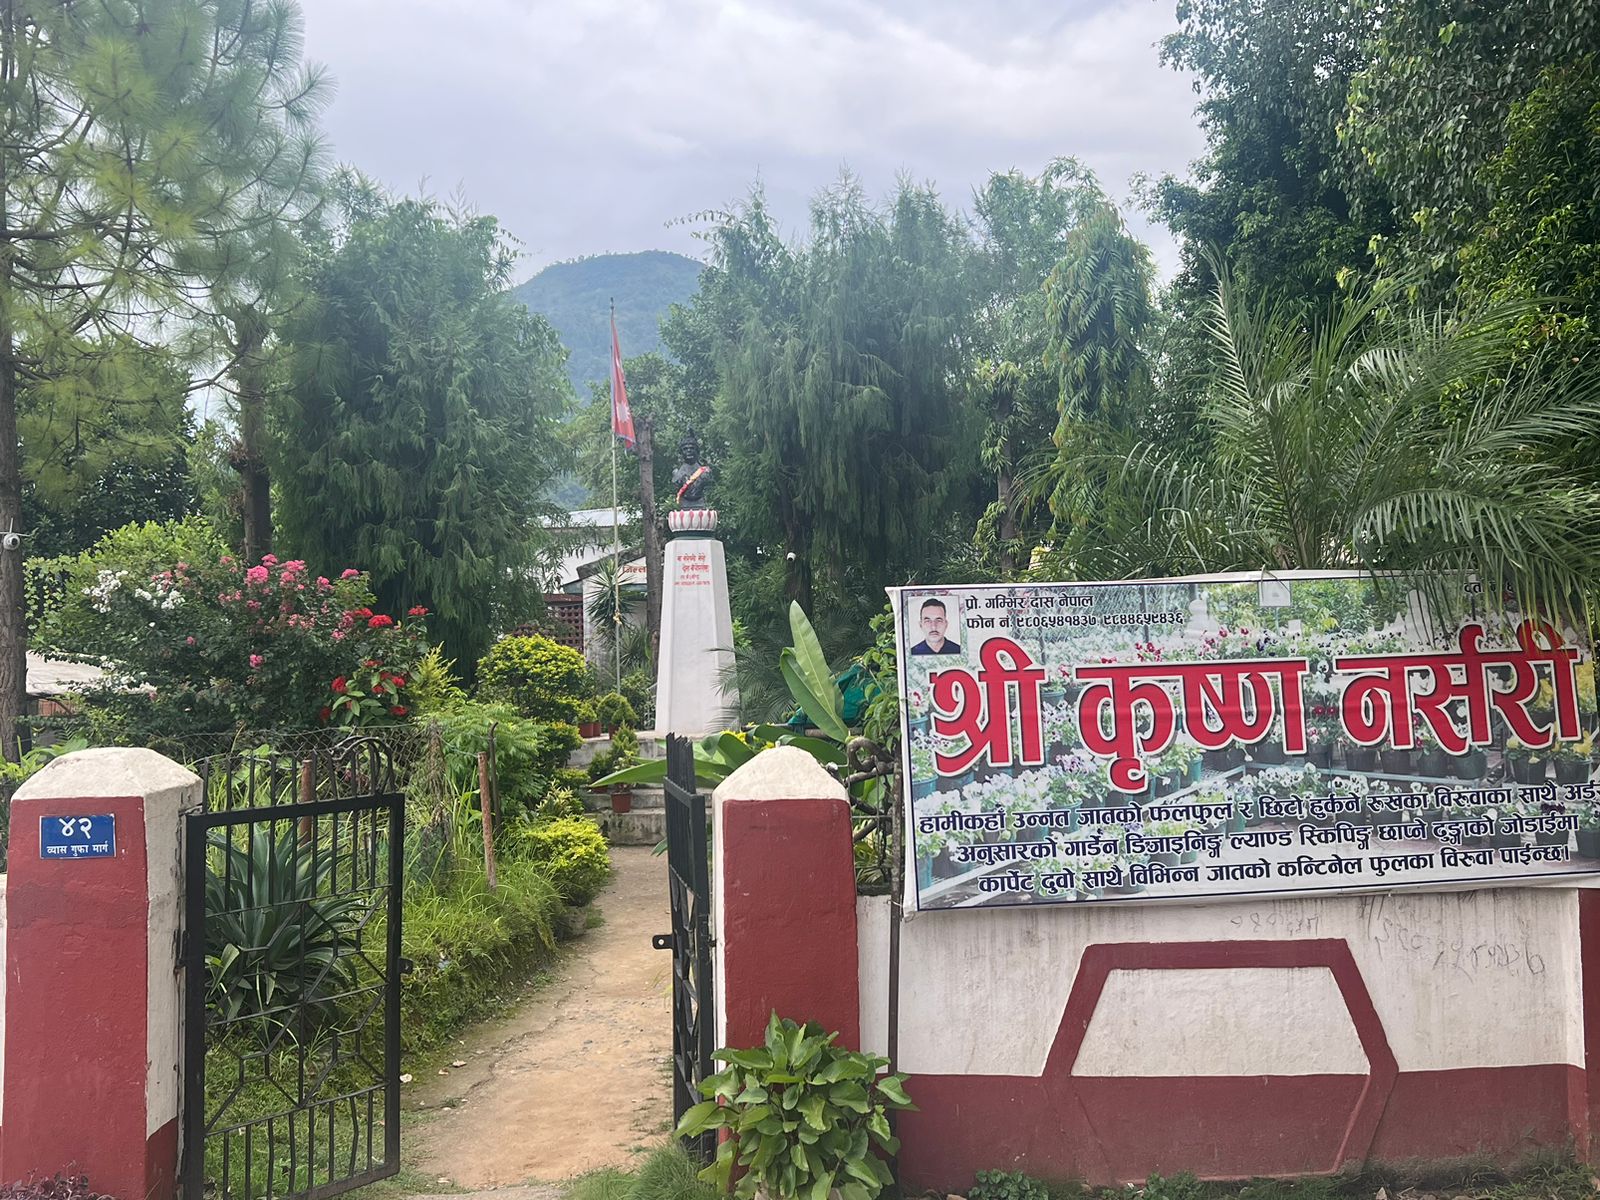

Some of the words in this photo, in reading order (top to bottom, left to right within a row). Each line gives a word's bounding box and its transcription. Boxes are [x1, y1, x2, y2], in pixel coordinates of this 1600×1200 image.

[1030, 597, 1054, 608] दास
[1059, 593, 1093, 607] नेपाल
[967, 614, 995, 628] फोन
[930, 637, 1048, 776] श्री
[1073, 658, 1310, 794] कृष्ण
[1333, 618, 1582, 756] नर्सरी
[1013, 811, 1071, 828] उन्नत
[1077, 802, 1142, 825] जातको
[1149, 803, 1233, 822] फलफुल
[1239, 802, 1252, 818] र
[1309, 792, 1361, 817] हुर्कने
[1518, 780, 1557, 803] साथै
[1563, 780, 1600, 801] अर्ड
[58, 817, 93, 840] ४२
[957, 837, 1057, 865] अनुसारको
[1064, 829, 1119, 856] गार्डेन
[1230, 830, 1293, 850] ल्याण्ड
[1378, 818, 1427, 841] छाप्ने
[1500, 811, 1579, 834] जोडाईमा
[46, 845, 68, 855] व्यास
[70, 844, 89, 857] गुफा
[92, 840, 109, 853] मार्ग
[978, 870, 1034, 893] कार्पेट
[1081, 865, 1124, 888] साथै
[1130, 862, 1200, 886] विभिन्न
[1206, 857, 1271, 882] जातको
[1369, 853, 1435, 877] फुलका
